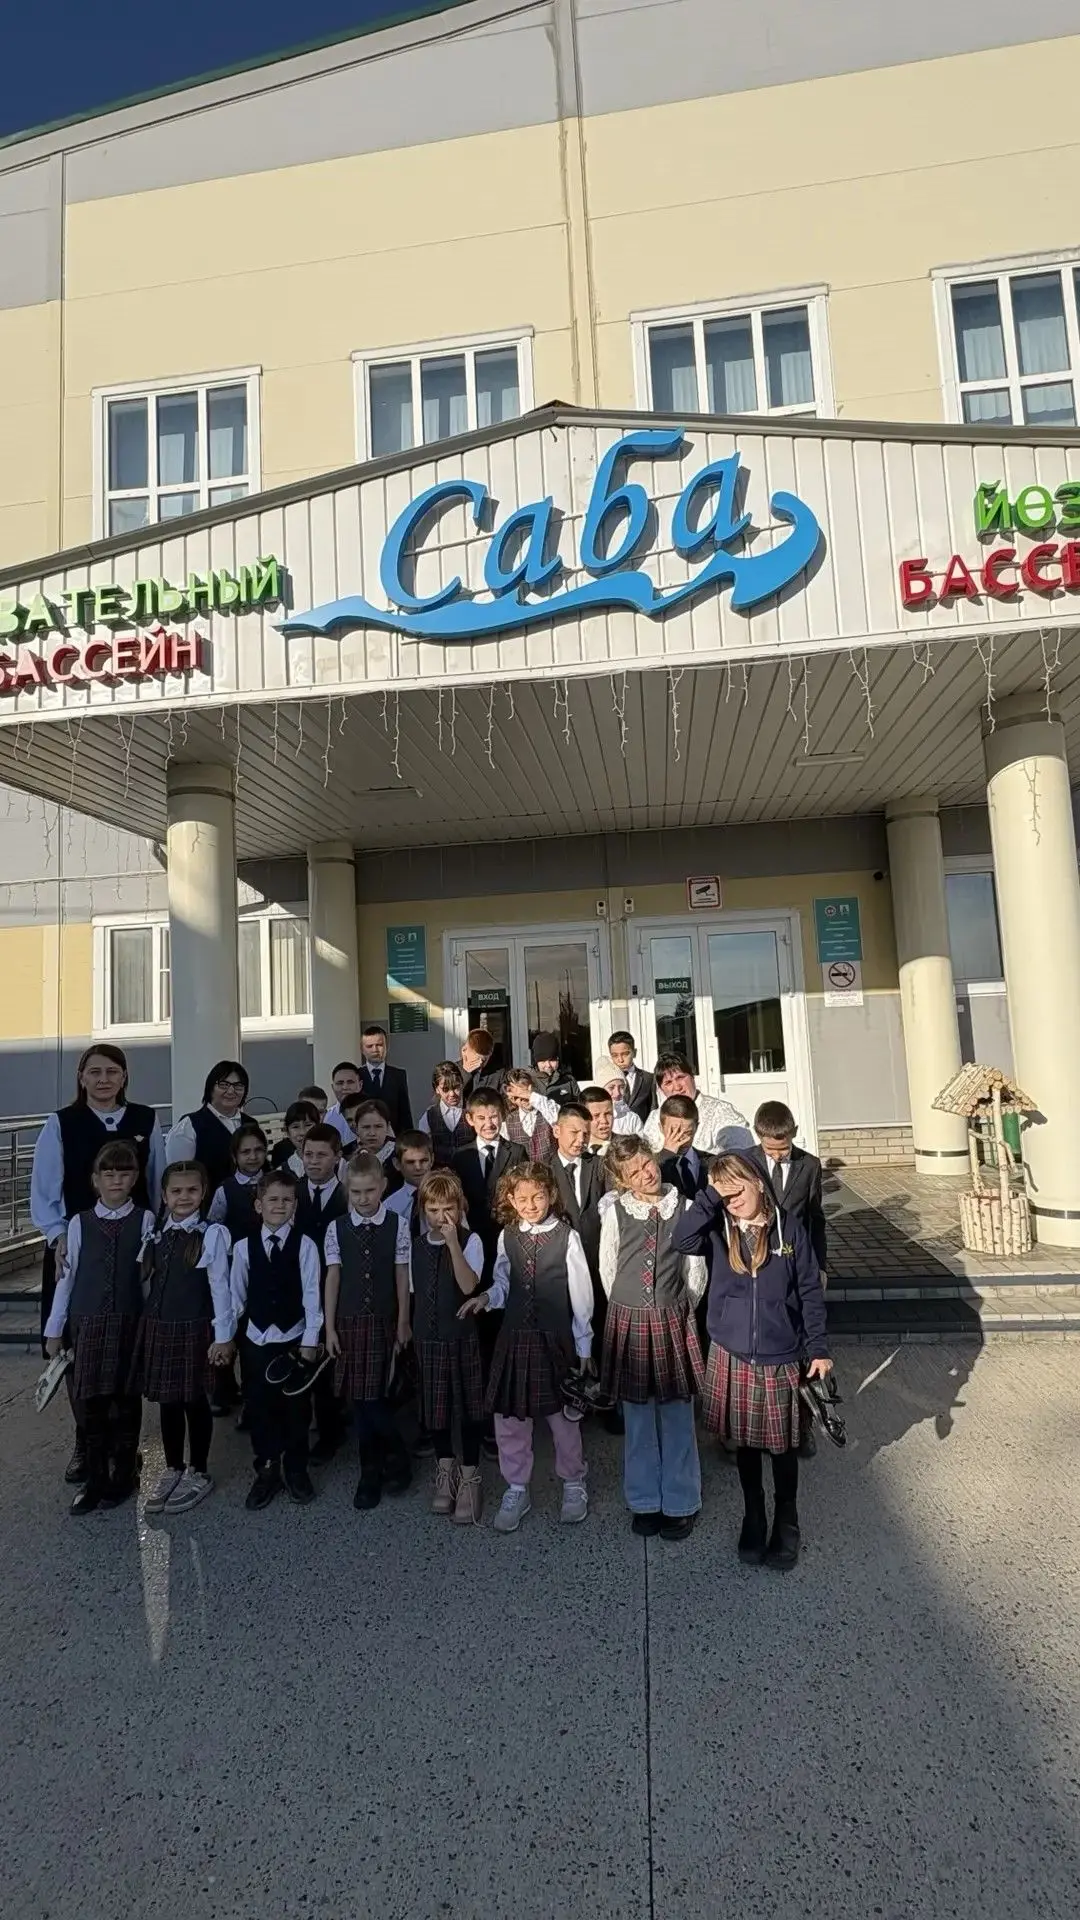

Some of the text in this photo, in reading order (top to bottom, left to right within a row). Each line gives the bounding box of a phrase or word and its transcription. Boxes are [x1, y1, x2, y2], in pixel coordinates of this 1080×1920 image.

[379, 427, 753, 613] Саба
[0, 626, 201, 686] АССЕЙН
[478, 992, 500, 1001] ВХОД
[658, 981, 689, 990] ВЫХОД
